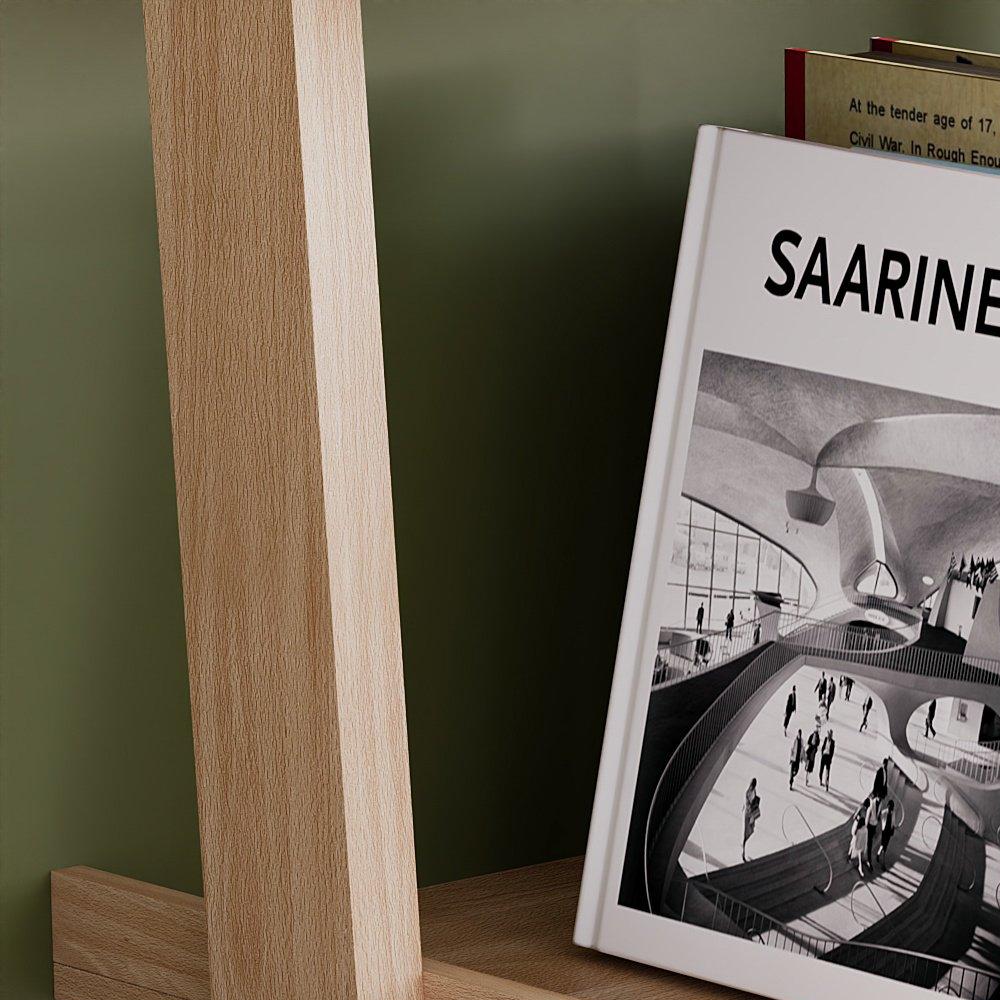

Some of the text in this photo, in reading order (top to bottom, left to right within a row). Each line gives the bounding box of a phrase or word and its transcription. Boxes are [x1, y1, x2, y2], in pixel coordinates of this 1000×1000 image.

[850, 98, 862, 112] At
[867, 101, 886, 117] the
[890, 105, 927, 123] tender
[933, 113, 955, 129] age
[961, 116, 973, 130] of
[979, 118, 996, 136] 17,
[850, 131, 874, 148] Civil
[911, 140, 922, 156] In
[927, 143, 965, 163] Rough
